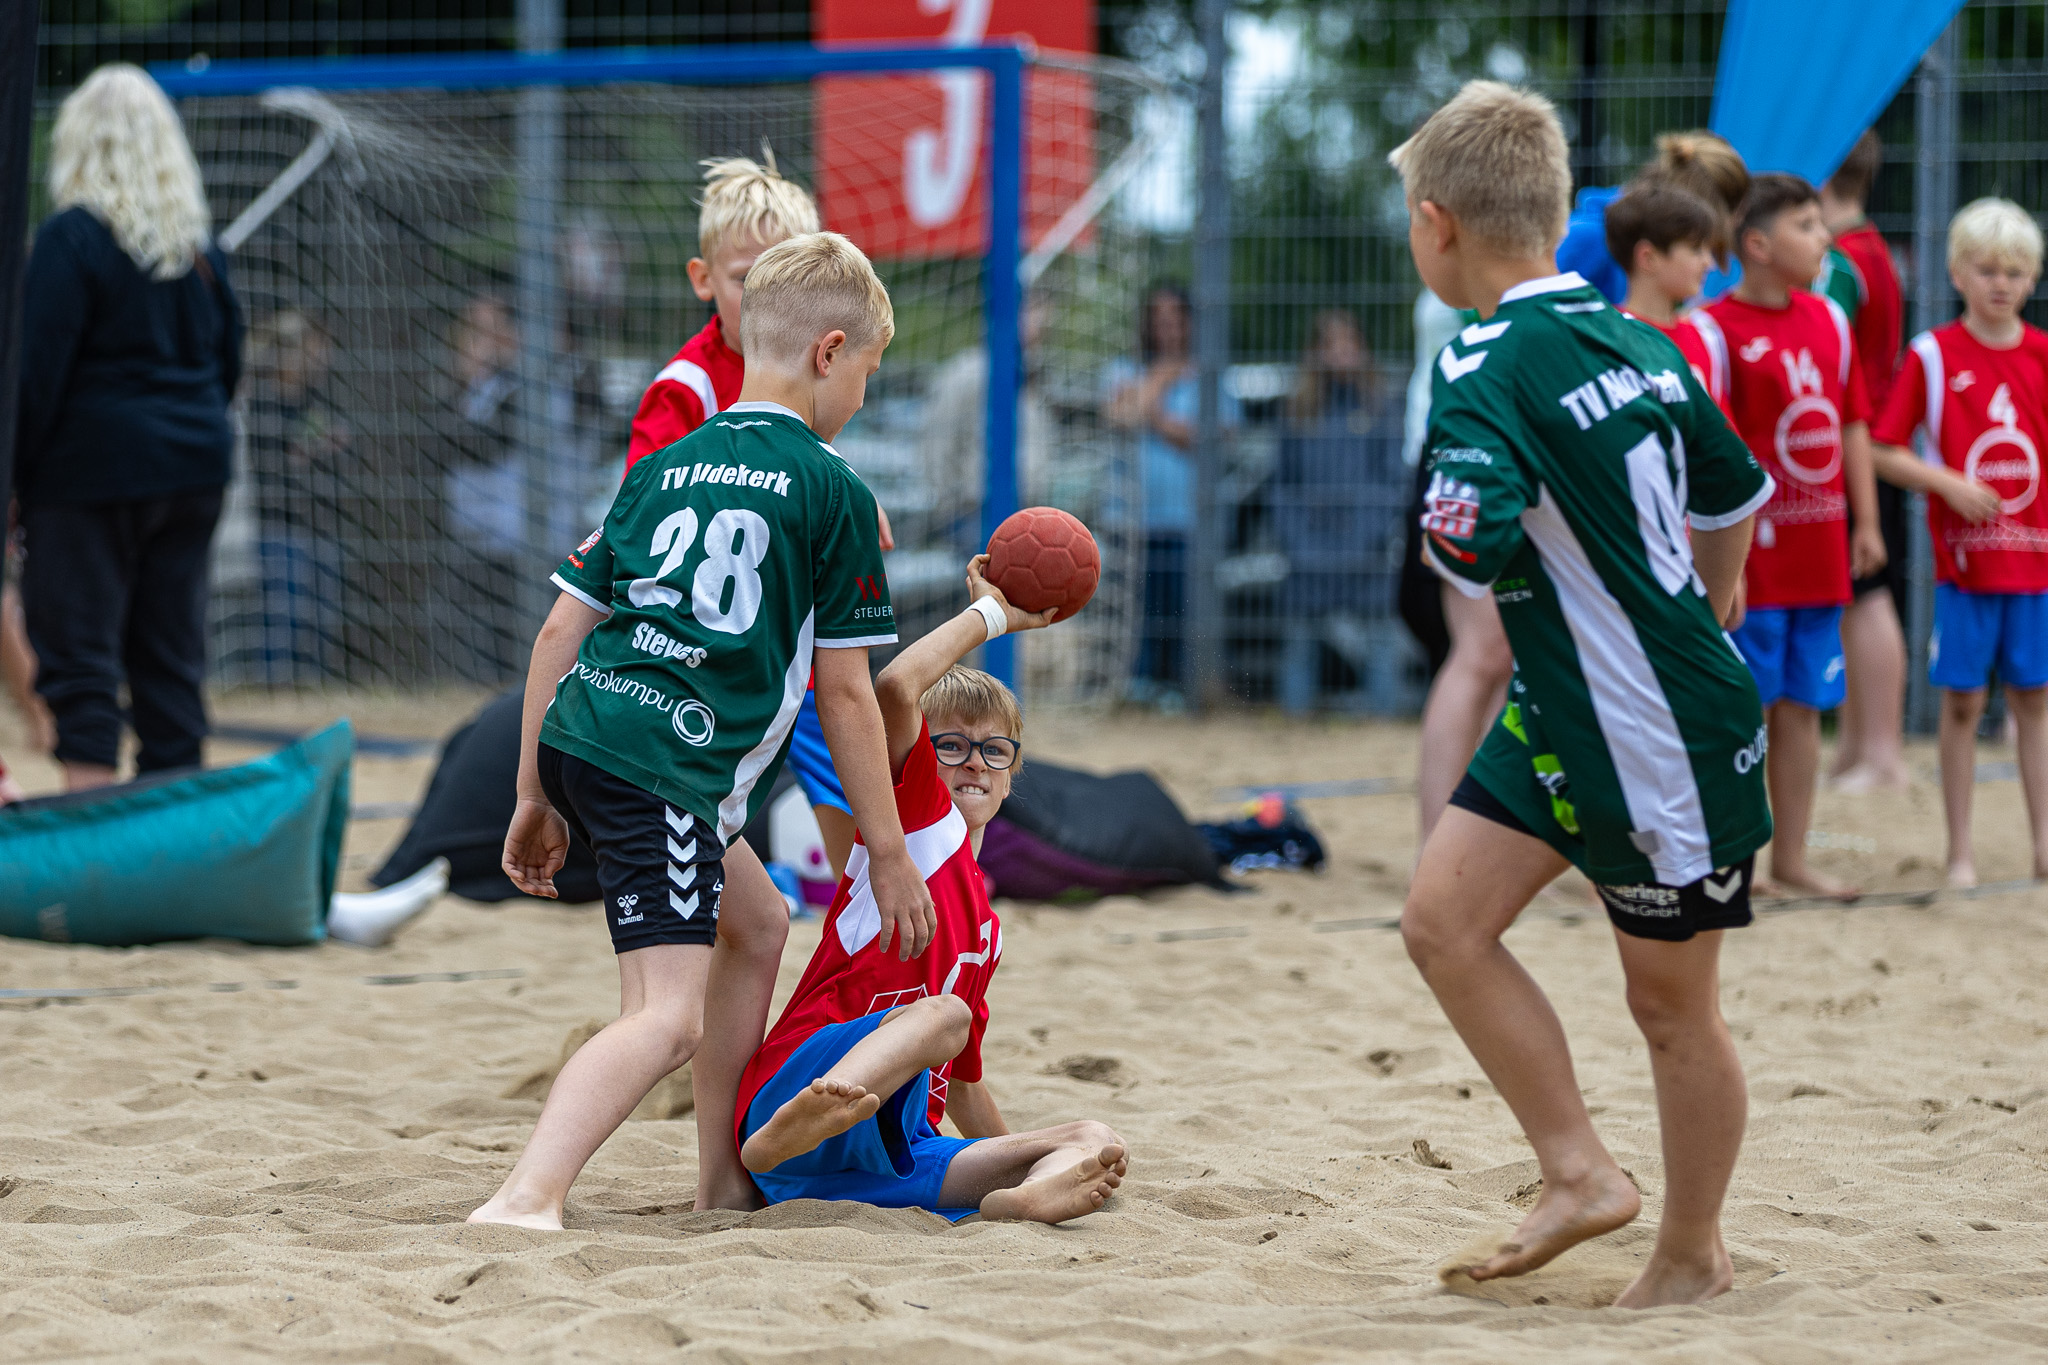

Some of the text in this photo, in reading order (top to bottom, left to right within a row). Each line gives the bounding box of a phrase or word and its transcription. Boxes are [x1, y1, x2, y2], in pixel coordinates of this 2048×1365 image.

[1558, 380, 1610, 432] TV
[1987, 382, 2018, 435] 4
[661, 466, 690, 490] TV
[627, 506, 770, 635] 28
[854, 605, 894, 619] STEUER
[632, 622, 707, 668] Steves
[618, 912, 644, 926] hummel
[1639, 905, 1681, 917] GmbH
